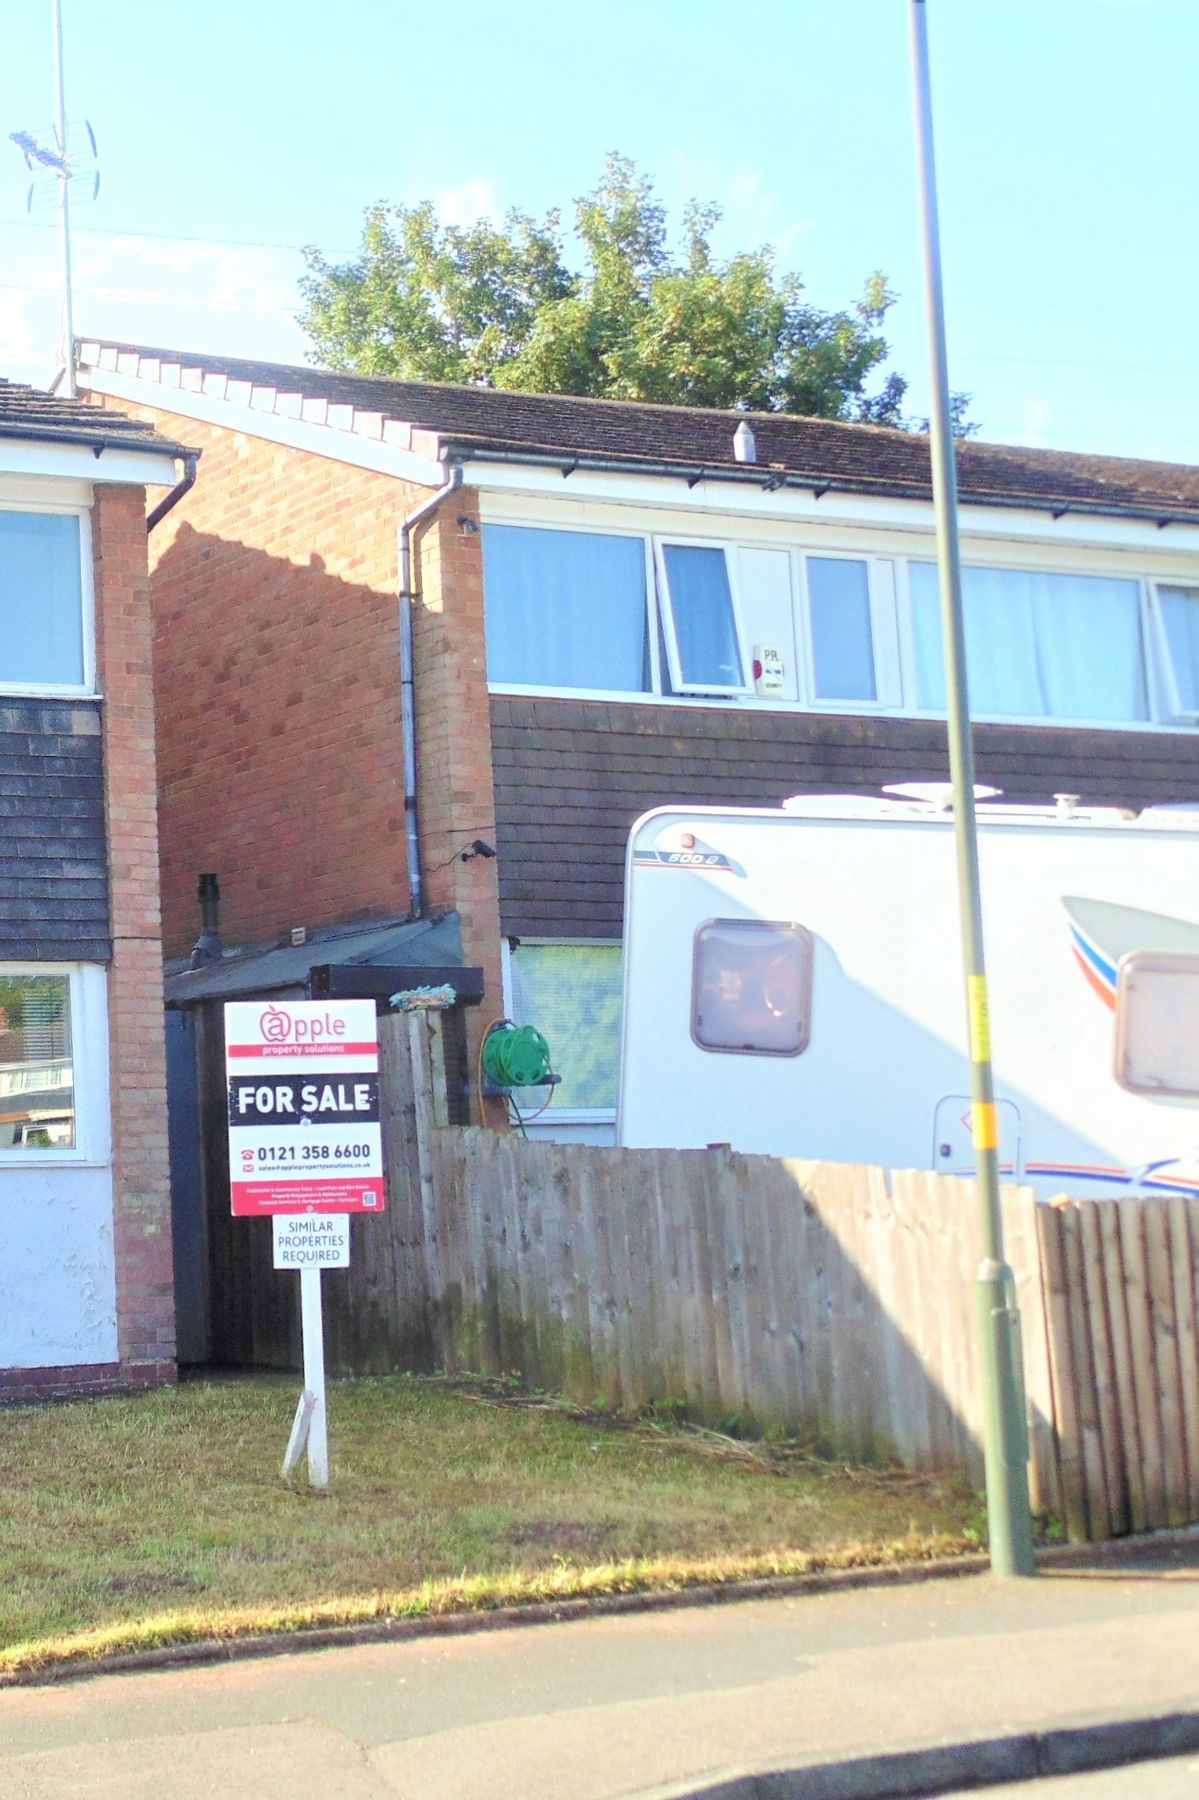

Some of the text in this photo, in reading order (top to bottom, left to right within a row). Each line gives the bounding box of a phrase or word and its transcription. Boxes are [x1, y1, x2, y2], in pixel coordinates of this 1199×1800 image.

[262, 1043, 345, 1056] property solutions
[238, 1084, 371, 1114] FOR SALE
[258, 1144, 370, 1161] 0121 358 6600
[288, 1221, 334, 1233] SIMILAR
[278, 1235, 344, 1247] PROPERTIES
[282, 1250, 341, 1263] REQUIRED
